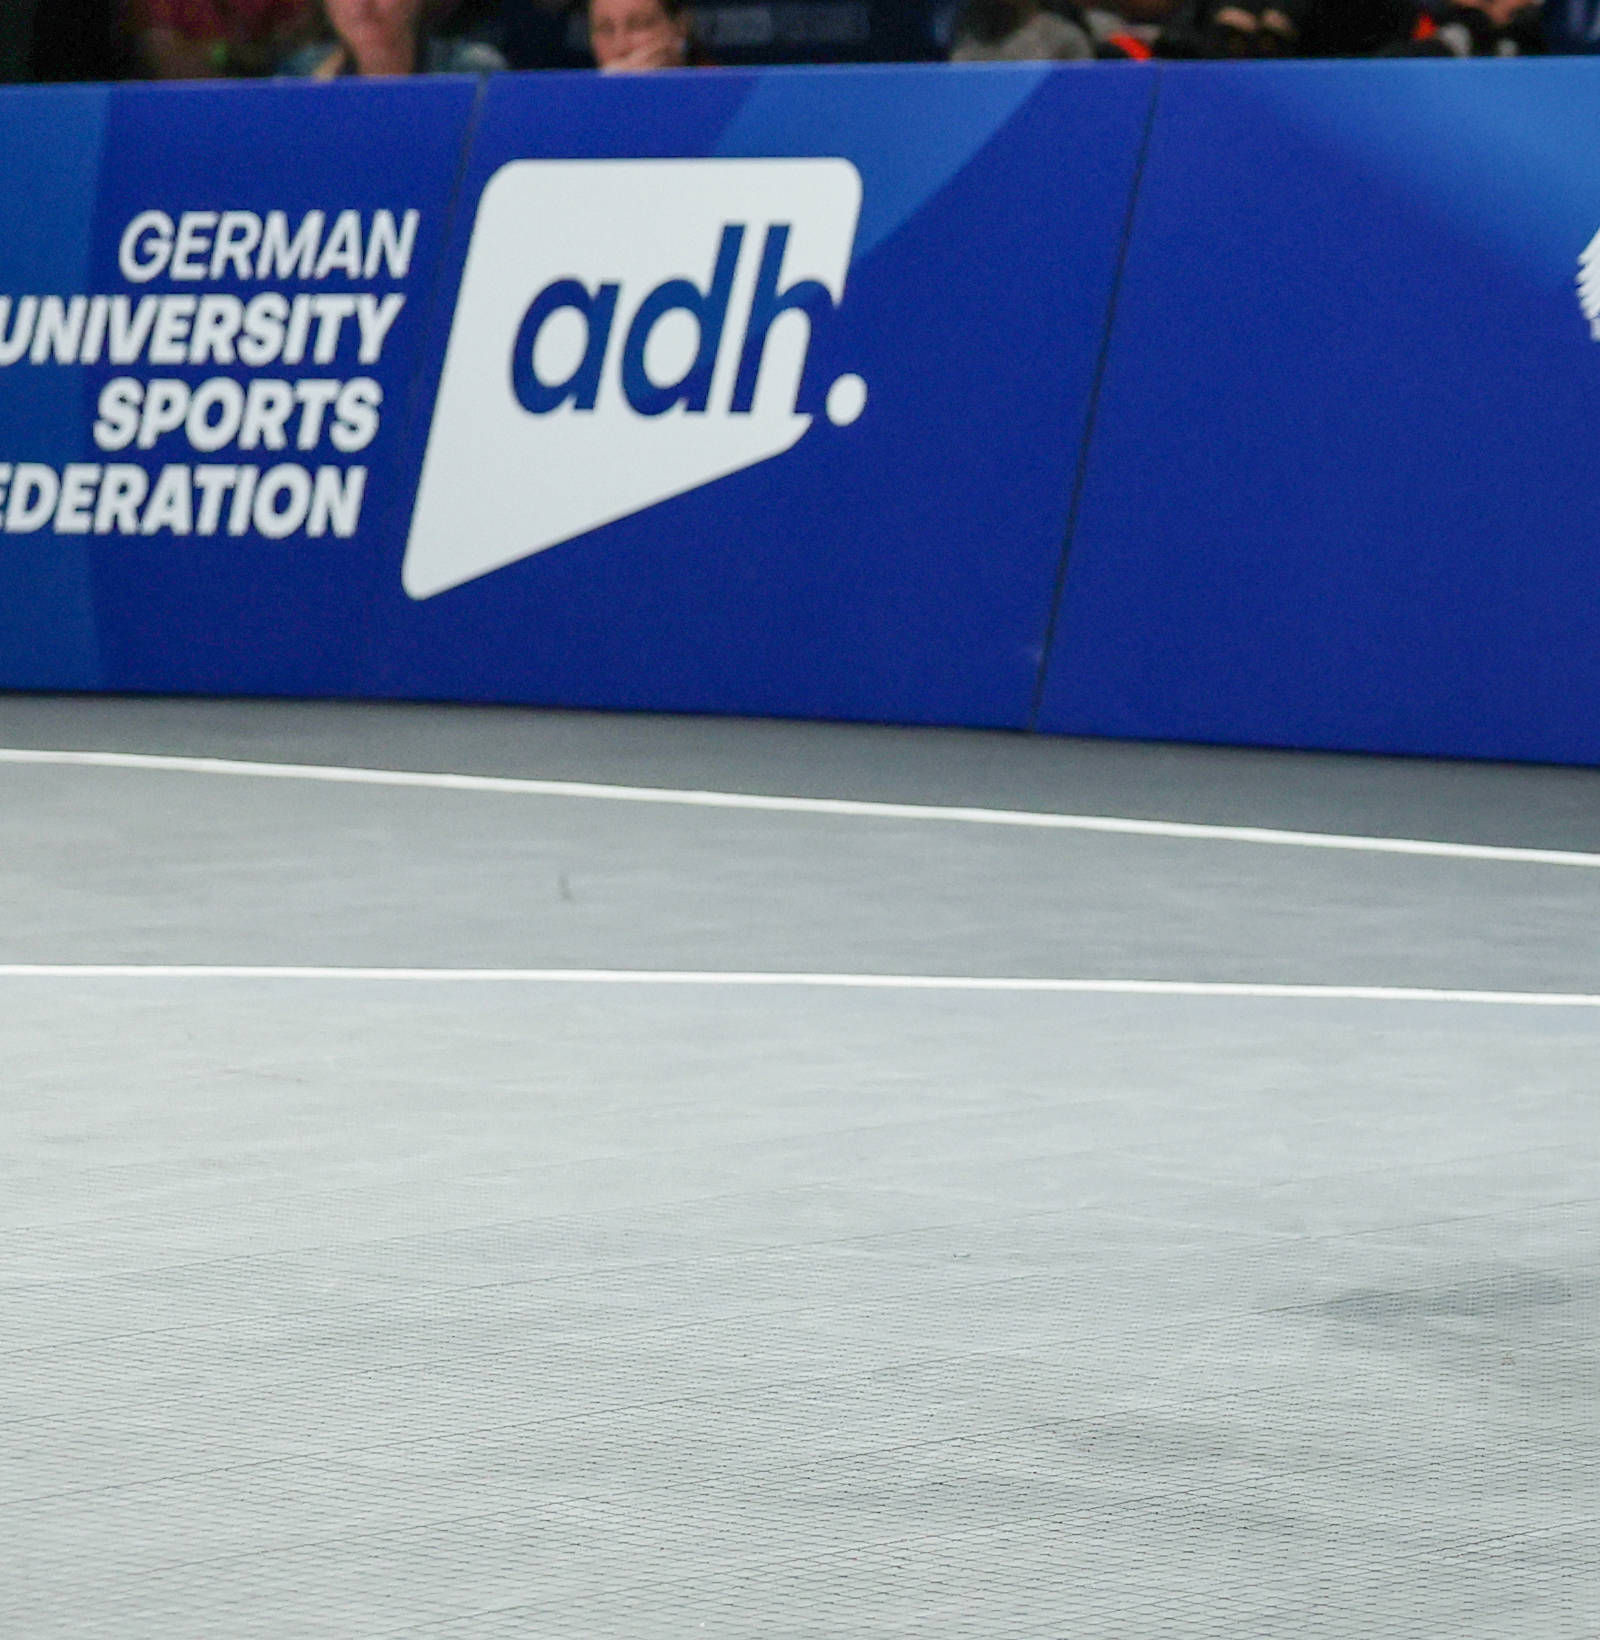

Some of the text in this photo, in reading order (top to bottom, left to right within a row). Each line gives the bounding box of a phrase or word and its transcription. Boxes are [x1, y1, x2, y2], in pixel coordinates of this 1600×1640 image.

[118, 210, 419, 282] GERMAN
[0, 293, 405, 366] UNIVERSITY
[93, 376, 383, 453] SPORTS
[0, 462, 366, 537] DERATION
